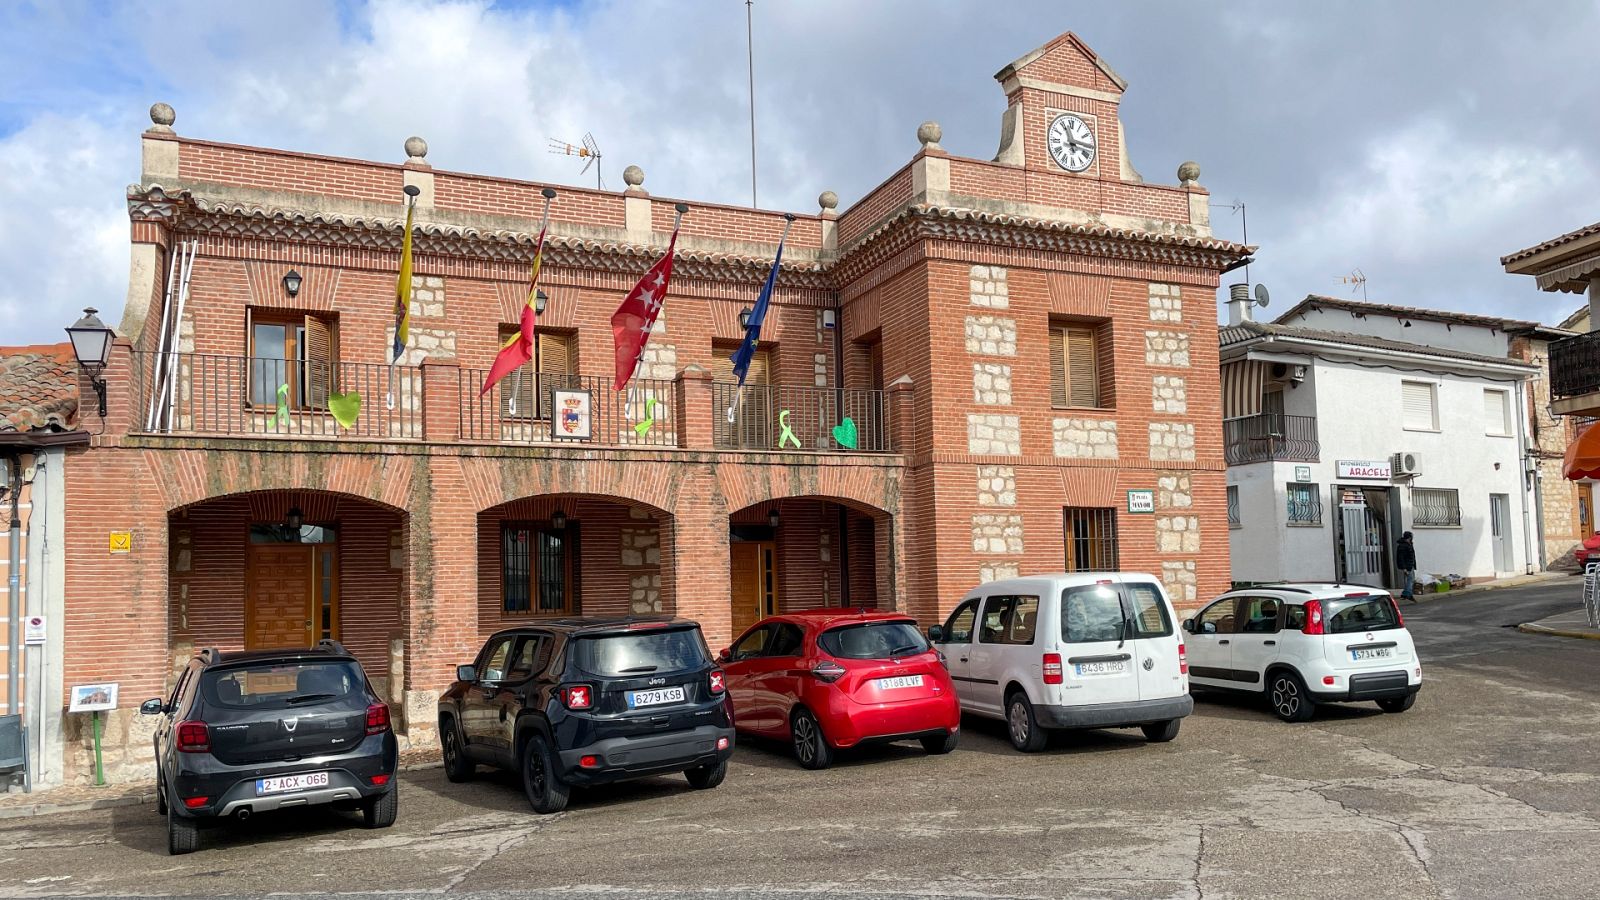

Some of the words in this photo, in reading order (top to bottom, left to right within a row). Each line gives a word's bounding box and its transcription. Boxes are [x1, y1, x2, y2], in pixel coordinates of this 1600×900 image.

[1350, 468, 1390, 476] ARACELI
[1081, 663, 1105, 674] 6436
[883, 679, 905, 688] 3188
[906, 676, 920, 686] LVF
[635, 692, 661, 705] 6279
[663, 689, 682, 701] KSB
